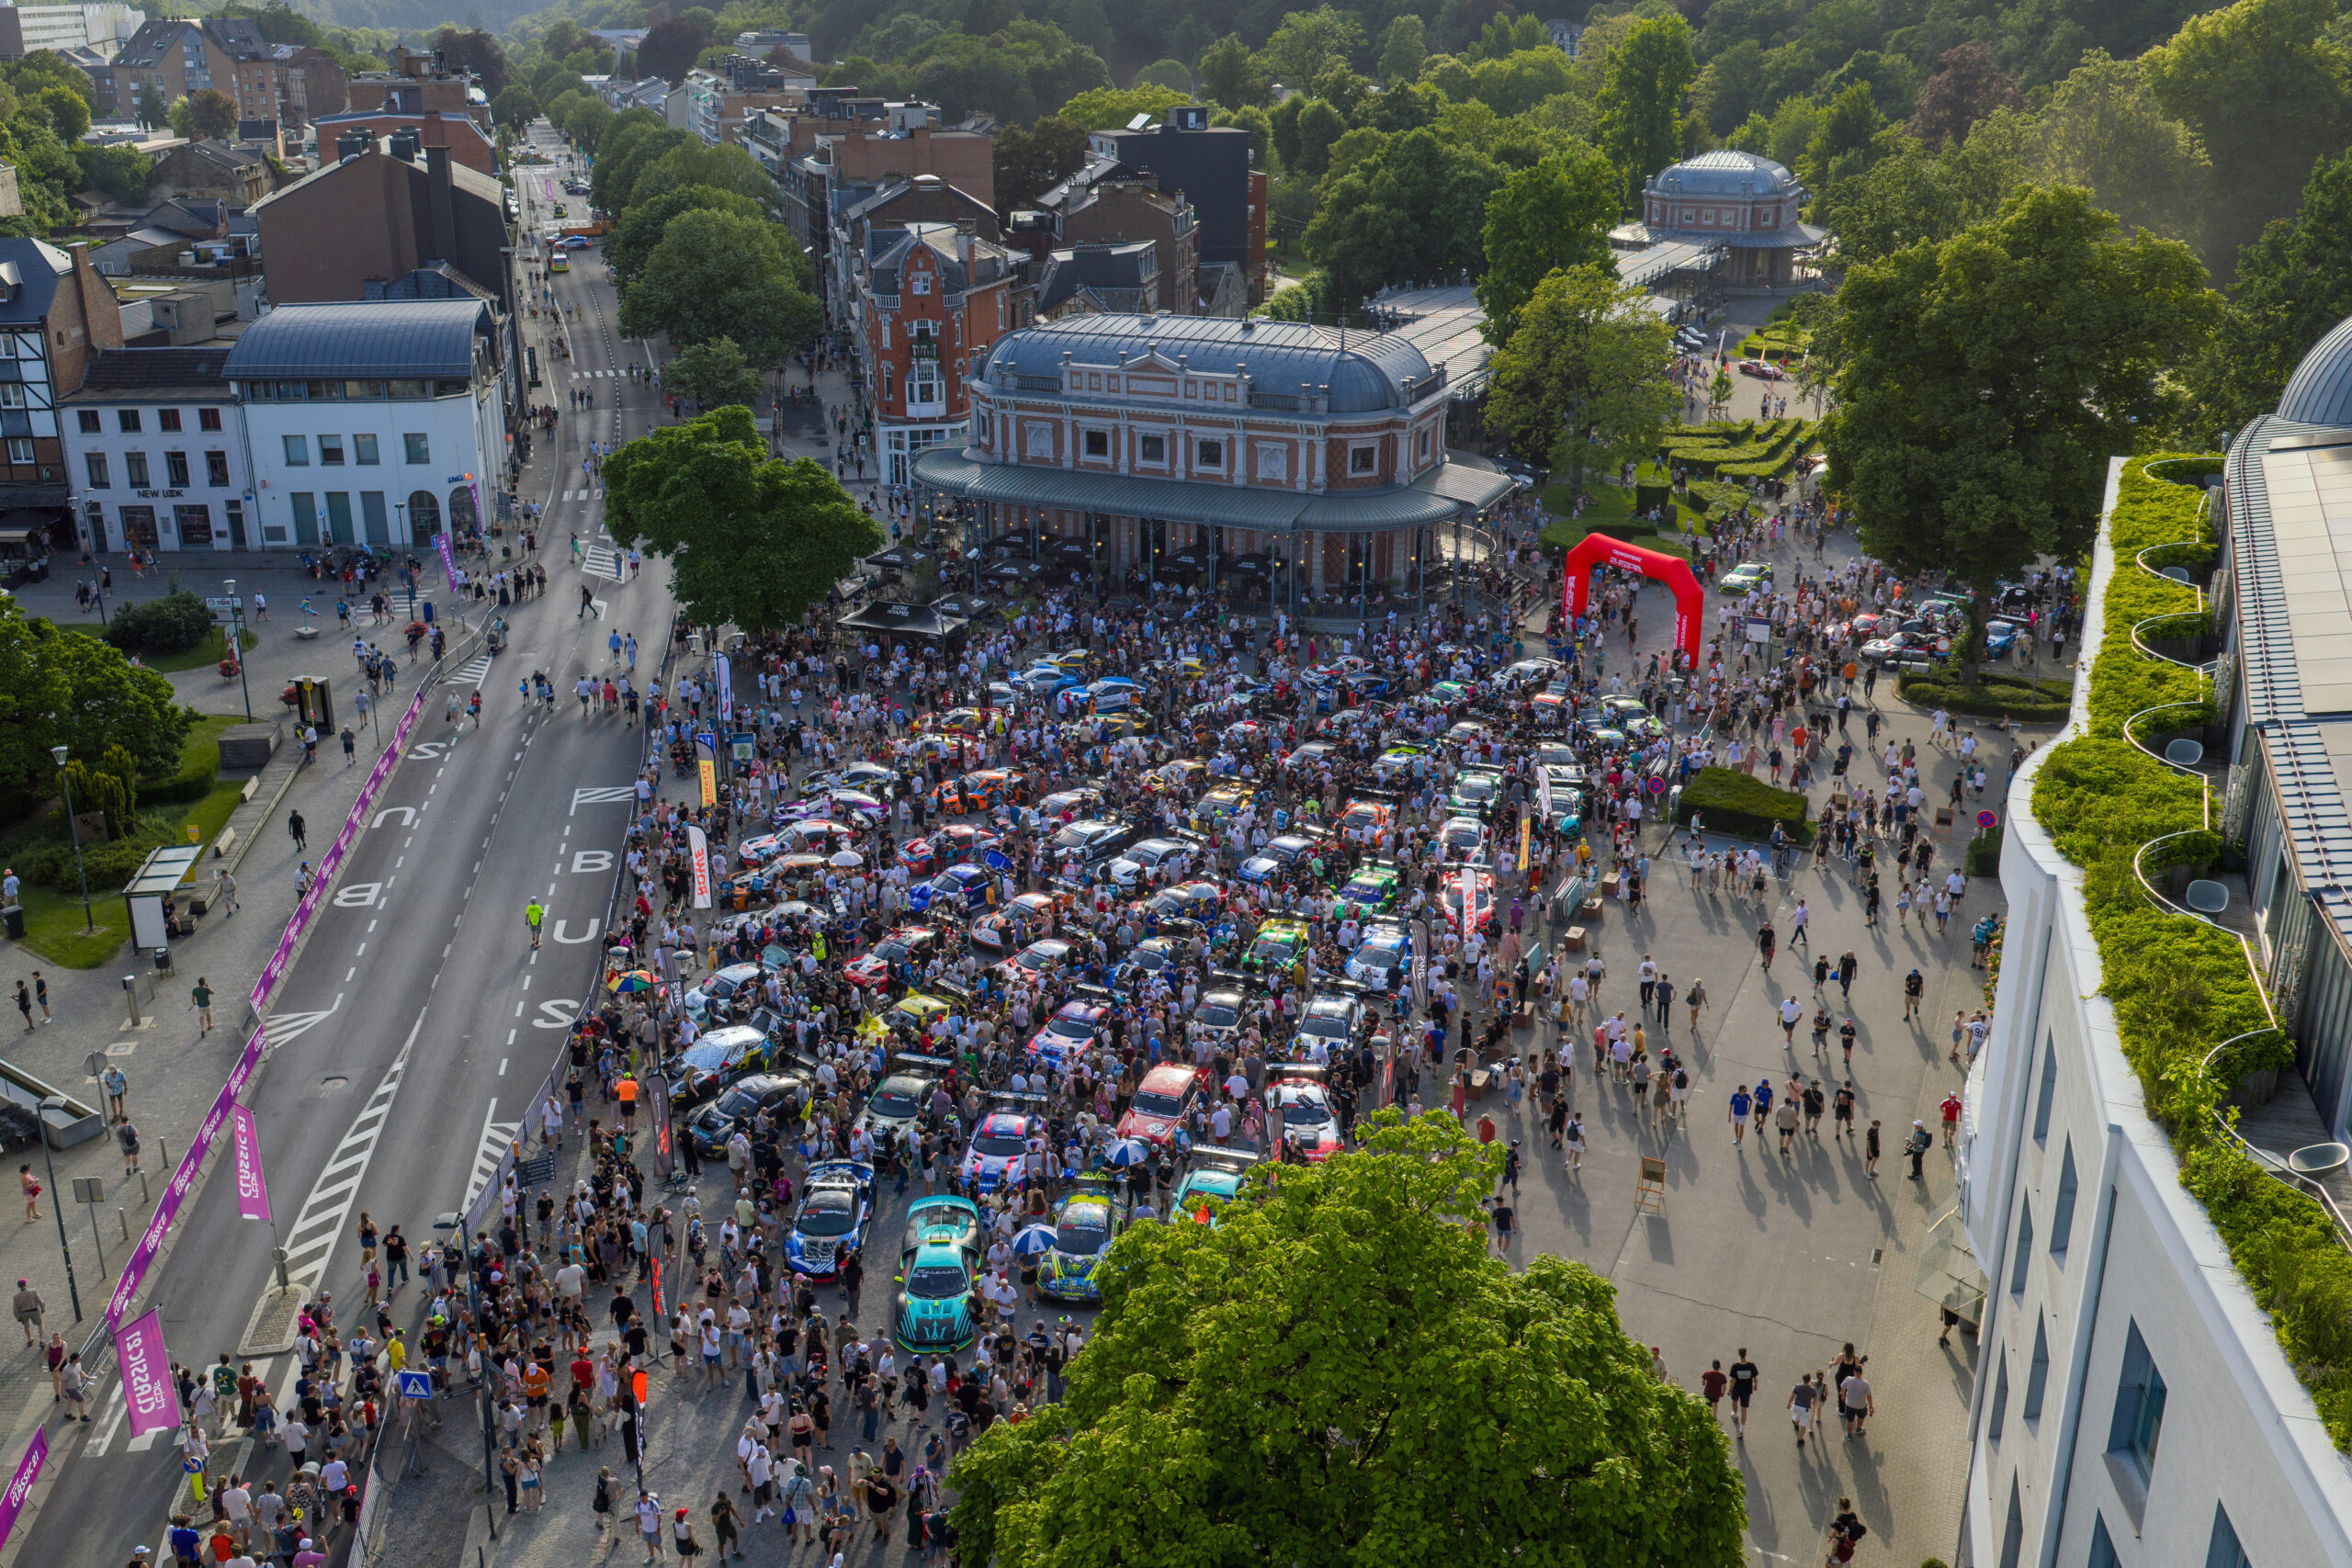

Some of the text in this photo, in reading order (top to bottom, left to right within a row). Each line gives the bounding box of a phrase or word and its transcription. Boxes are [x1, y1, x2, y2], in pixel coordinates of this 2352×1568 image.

[138, 489, 184, 498] NEW LOOK
[448, 475, 464, 483] ING
[146, 1221, 162, 1253] CLASSIC
[113, 1280, 130, 1316] CLASSIC
[11, 1459, 34, 1508] CLASSIC
